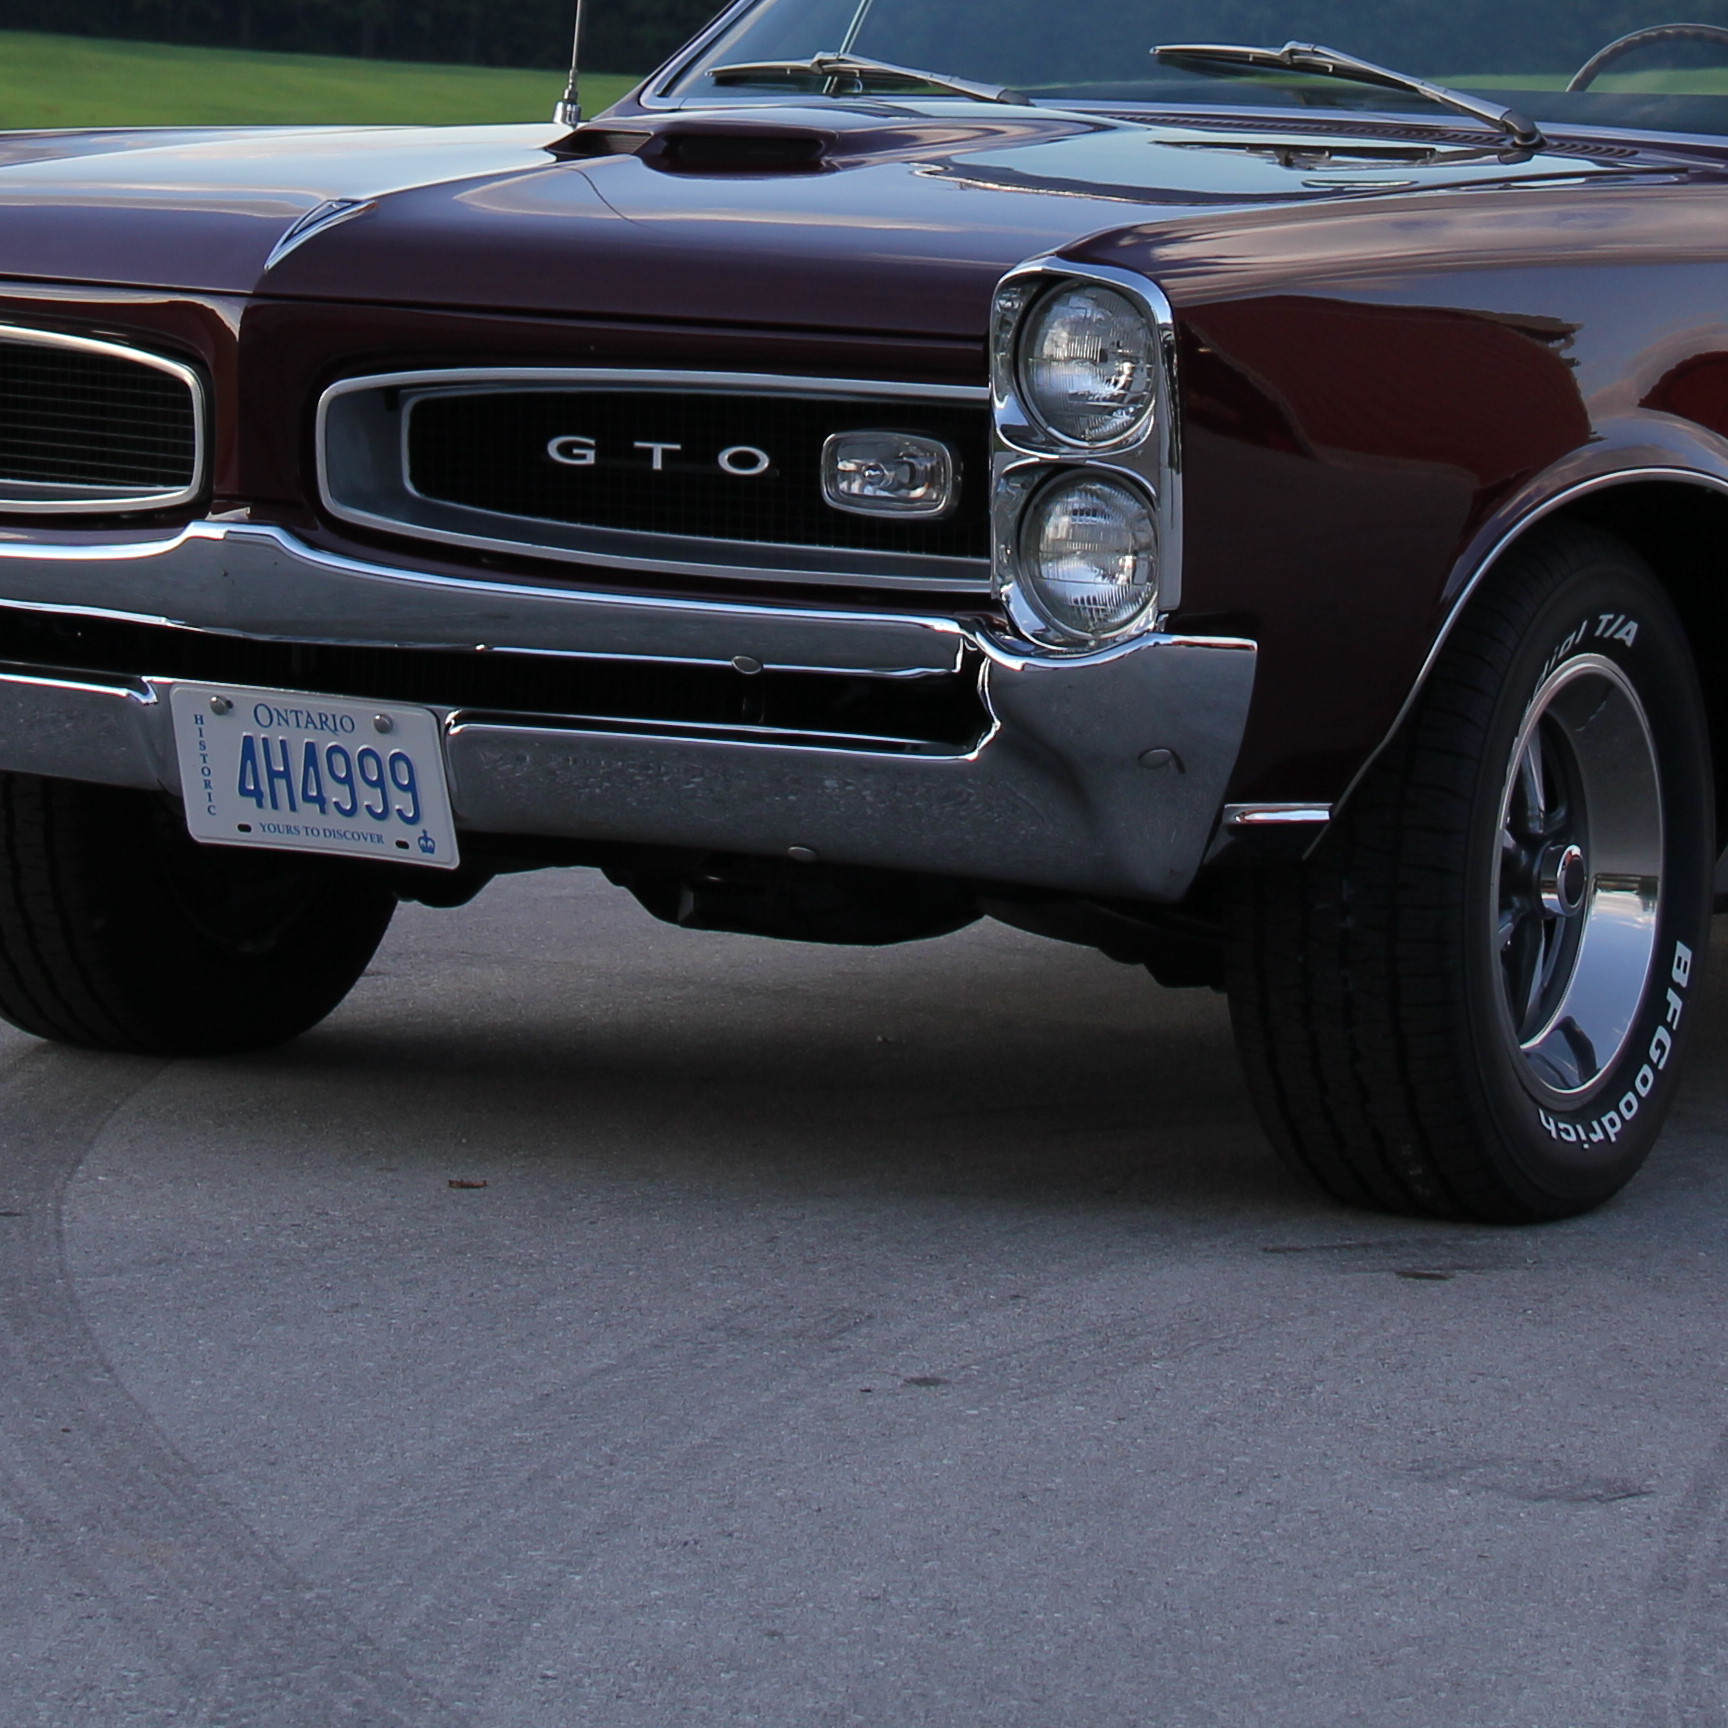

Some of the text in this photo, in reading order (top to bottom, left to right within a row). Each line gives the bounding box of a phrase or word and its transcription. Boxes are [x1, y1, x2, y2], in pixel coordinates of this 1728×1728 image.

[547, 436, 770, 475] GTO
[1594, 614, 1638, 647] T/A
[253, 703, 355, 736] ONTARIO
[194, 714, 216, 816] HISTORIC
[238, 733, 420, 824] 4H4999
[259, 822, 385, 845] YOURS TO DISCOVER
[1538, 940, 1692, 1149] BFGoodrich
